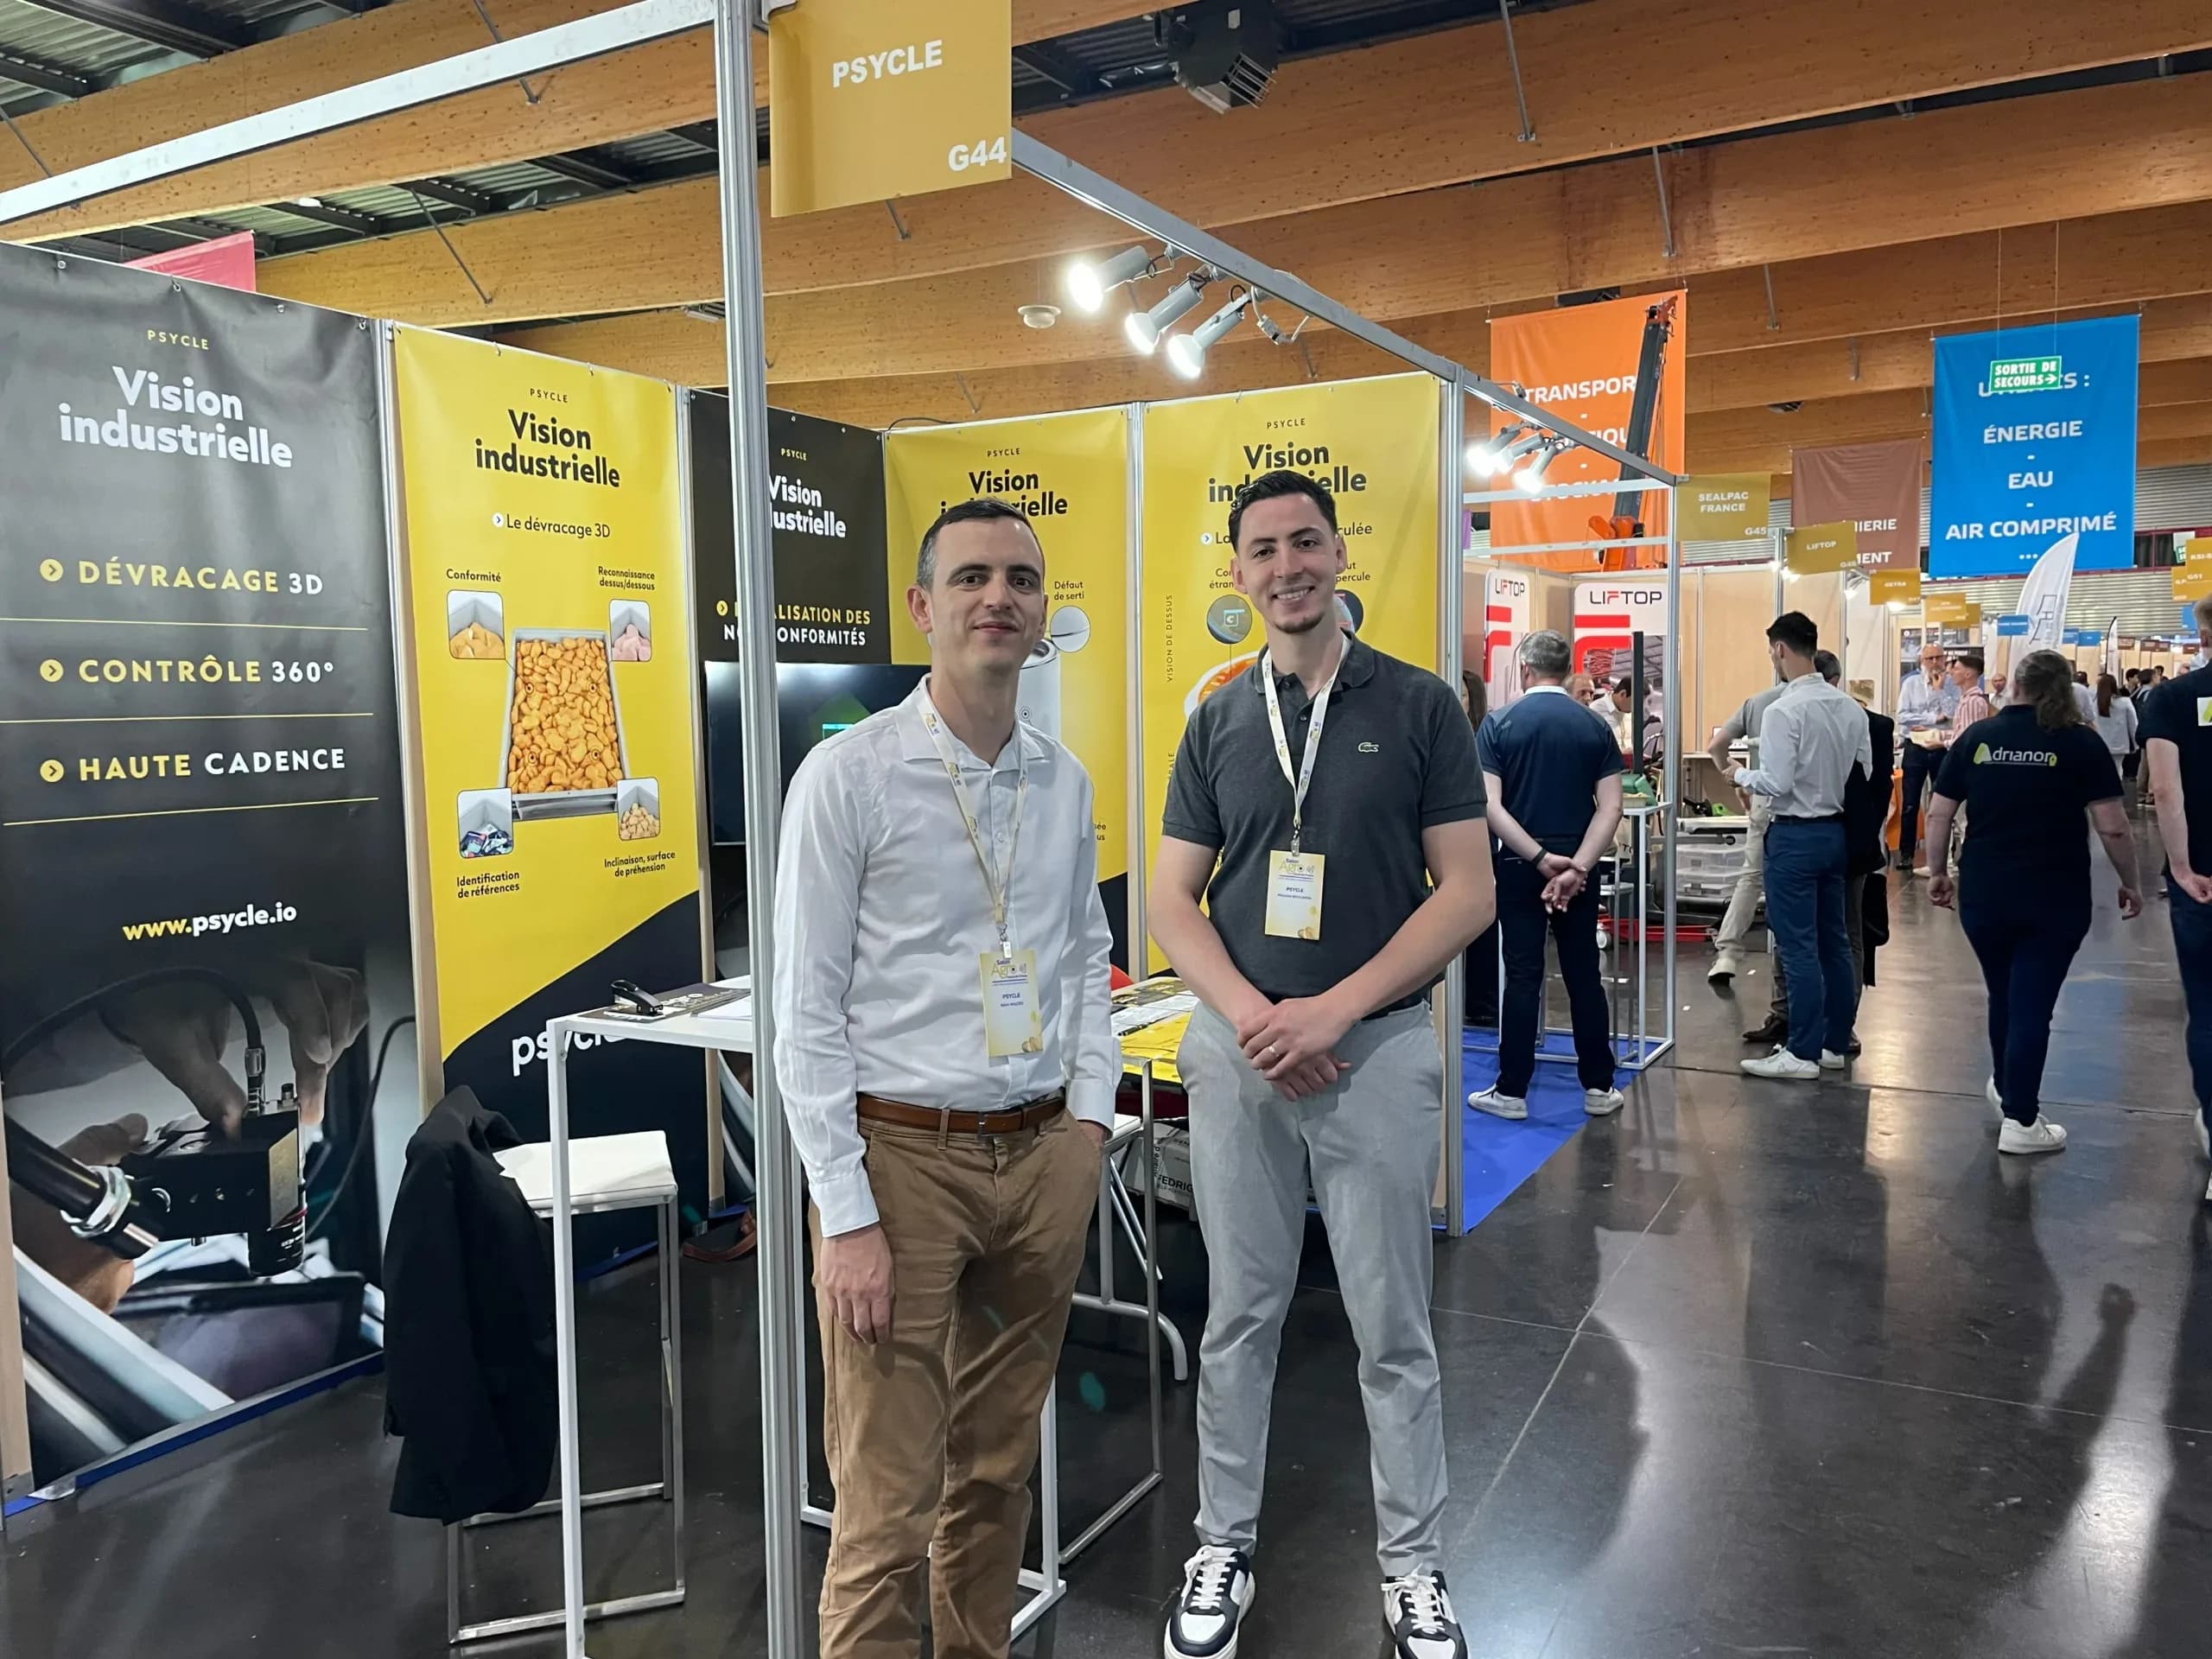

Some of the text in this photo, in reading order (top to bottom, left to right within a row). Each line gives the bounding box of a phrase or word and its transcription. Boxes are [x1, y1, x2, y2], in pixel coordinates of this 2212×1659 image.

[833, 40, 943, 87] PSYCLE
[948, 137, 1007, 172] G44
[148, 329, 209, 350] PSYCLE
[1994, 360, 2057, 376] SORTIE DE
[1524, 375, 1637, 404] TRANSPOR
[1994, 374, 2044, 388] SECOURS
[111, 365, 243, 421] Vision
[531, 388, 569, 404] PSYCLE
[508, 409, 591, 450] Vision
[1267, 417, 1306, 429] PSYCLE
[1983, 420, 2082, 444] ÉNERGIE
[59, 403, 292, 467] industrielle
[781, 448, 807, 461] PSYCLE
[987, 448, 1020, 457] PSYCLE
[1243, 442, 1330, 470] Vision
[475, 438, 620, 488] industrielle
[969, 468, 1039, 494] Vision
[1209, 465, 1367, 503] indelle
[2008, 471, 2053, 489] EAU
[769, 474, 822, 507] Vision
[1698, 492, 1749, 502] SEALPAC
[1700, 503, 1746, 513] FRANCE
[507, 514, 611, 538] Le dévracage 3D
[770, 501, 847, 537] ustrielle
[1945, 512, 2117, 541] AIR COMPRIMÉ
[1338, 522, 1373, 536] culée
[1745, 526, 1767, 536] G45
[79, 556, 324, 595] DÉVRACAGE 3D
[446, 569, 501, 582] Conformité
[598, 566, 655, 581] Reconnaissance
[1336, 572, 1370, 582] percule
[600, 577, 655, 591] dessus/dessous
[1054, 581, 1084, 589] Défaut
[1495, 579, 1525, 597] LIFTOP
[1054, 591, 1084, 601] de serti
[1590, 590, 1662, 605] LIFTOP
[846, 608, 871, 625] DES
[777, 626, 866, 646] ONFORMITÉS
[1166, 634, 1173, 645] DE
[79, 654, 334, 683] CONTRÔLE 360°
[79, 748, 346, 781] HAUTE CADENCE
[604, 850, 676, 870] Inclinaison, surface
[456, 871, 520, 887] Identification
[614, 862, 665, 879] de préhension
[457, 881, 520, 899] de références
[123, 901, 297, 941] www.psycle.io
